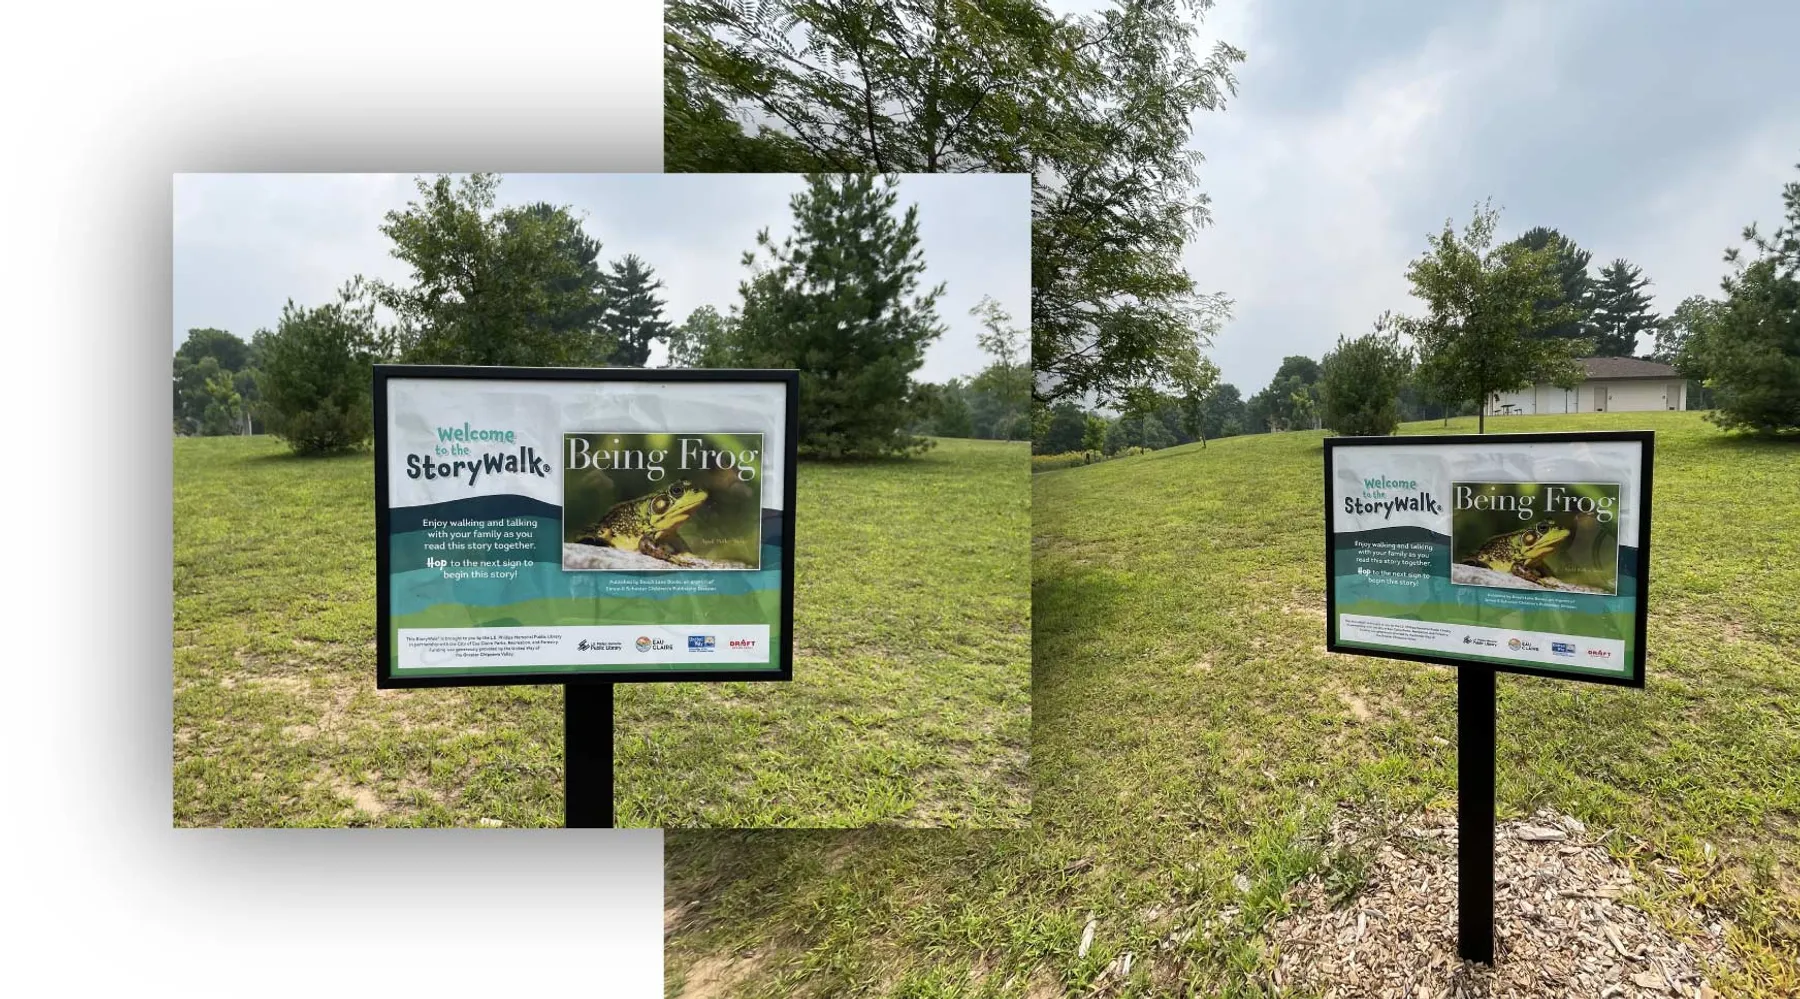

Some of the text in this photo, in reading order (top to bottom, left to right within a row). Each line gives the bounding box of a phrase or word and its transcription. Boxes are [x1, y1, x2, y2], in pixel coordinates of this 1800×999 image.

[438, 422, 516, 442] Welcome
[436, 444, 470, 456] to the
[565, 437, 759, 482] Being Frog
[1364, 474, 1417, 490] Welcome
[1373, 490, 1386, 499] the
[1454, 486, 1616, 522] Being Frog
[422, 518, 538, 528] Enjoy walking and talking
[450, 532, 472, 540] your
[474, 530, 501, 540] family
[516, 532, 532, 540] you
[424, 542, 446, 550] read
[468, 542, 492, 552] story
[494, 542, 536, 552] together.
[426, 556, 448, 570] Hop
[502, 559, 522, 568] sign
[444, 570, 518, 581] begin this story!
